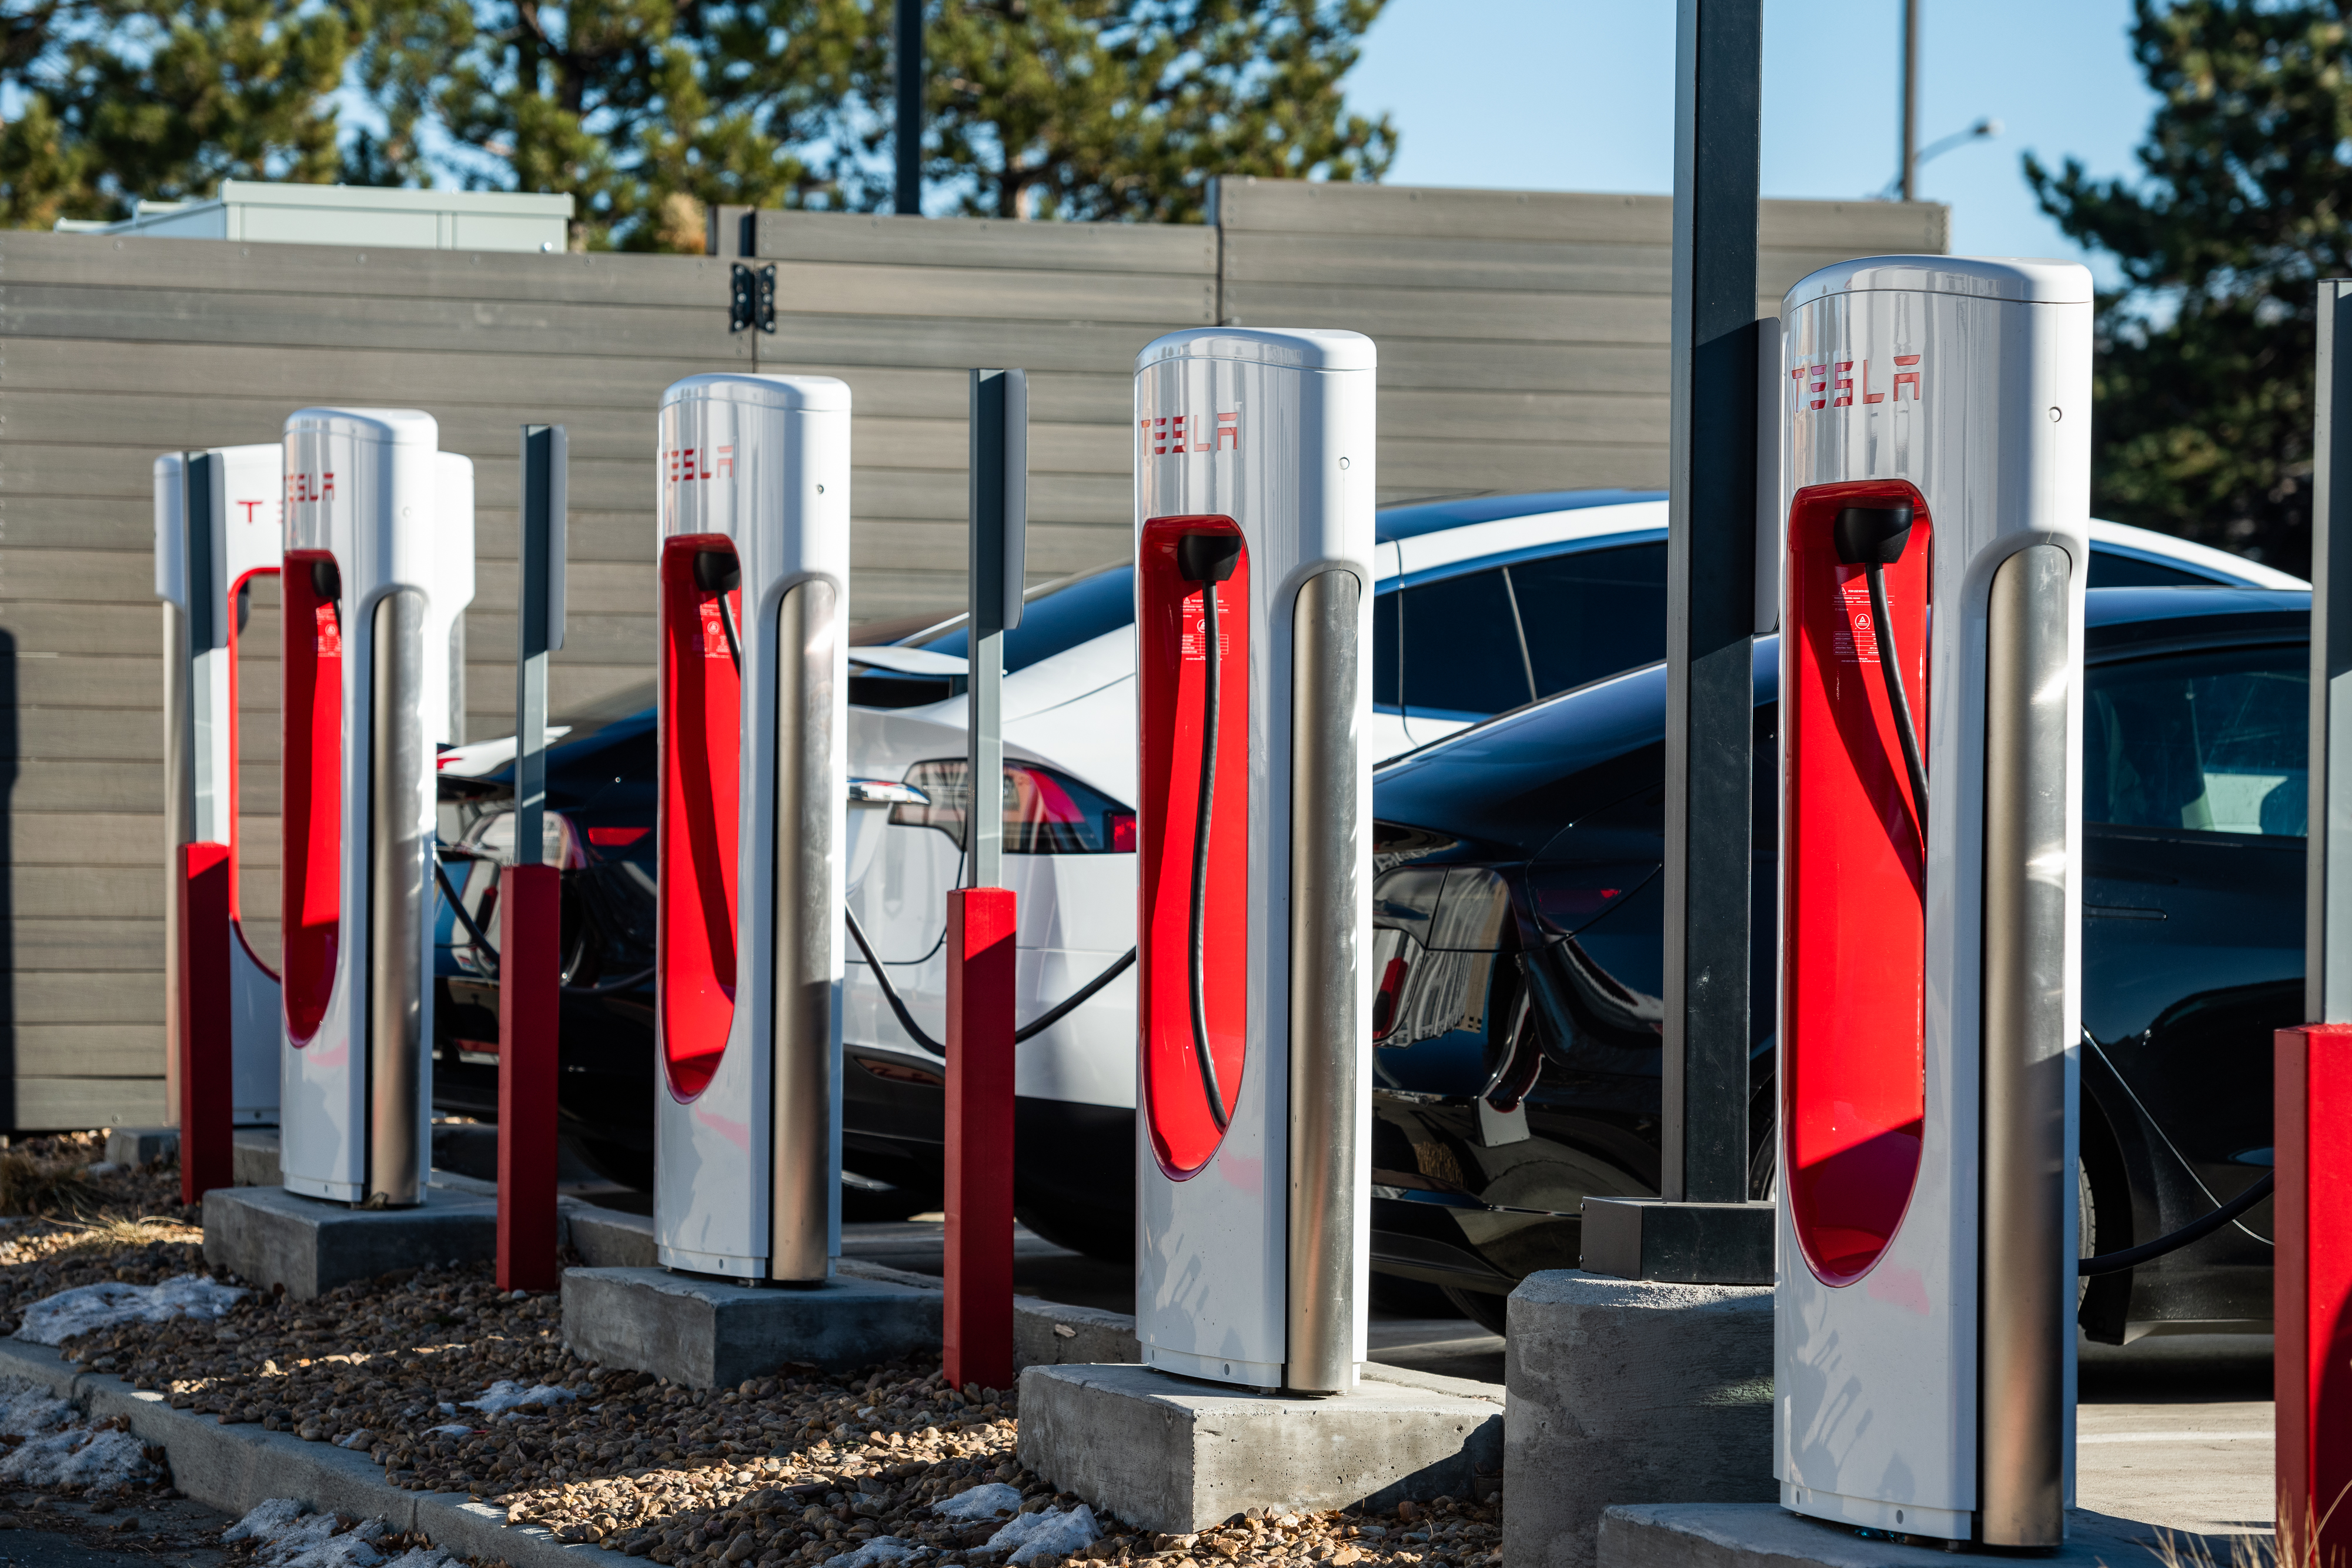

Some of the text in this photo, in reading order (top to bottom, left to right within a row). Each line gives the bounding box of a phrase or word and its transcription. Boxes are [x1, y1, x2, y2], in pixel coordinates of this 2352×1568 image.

[1791, 354, 1921, 413] TESLA
[1141, 412, 1238, 456] TESLA
[663, 444, 733, 483] TESLA
